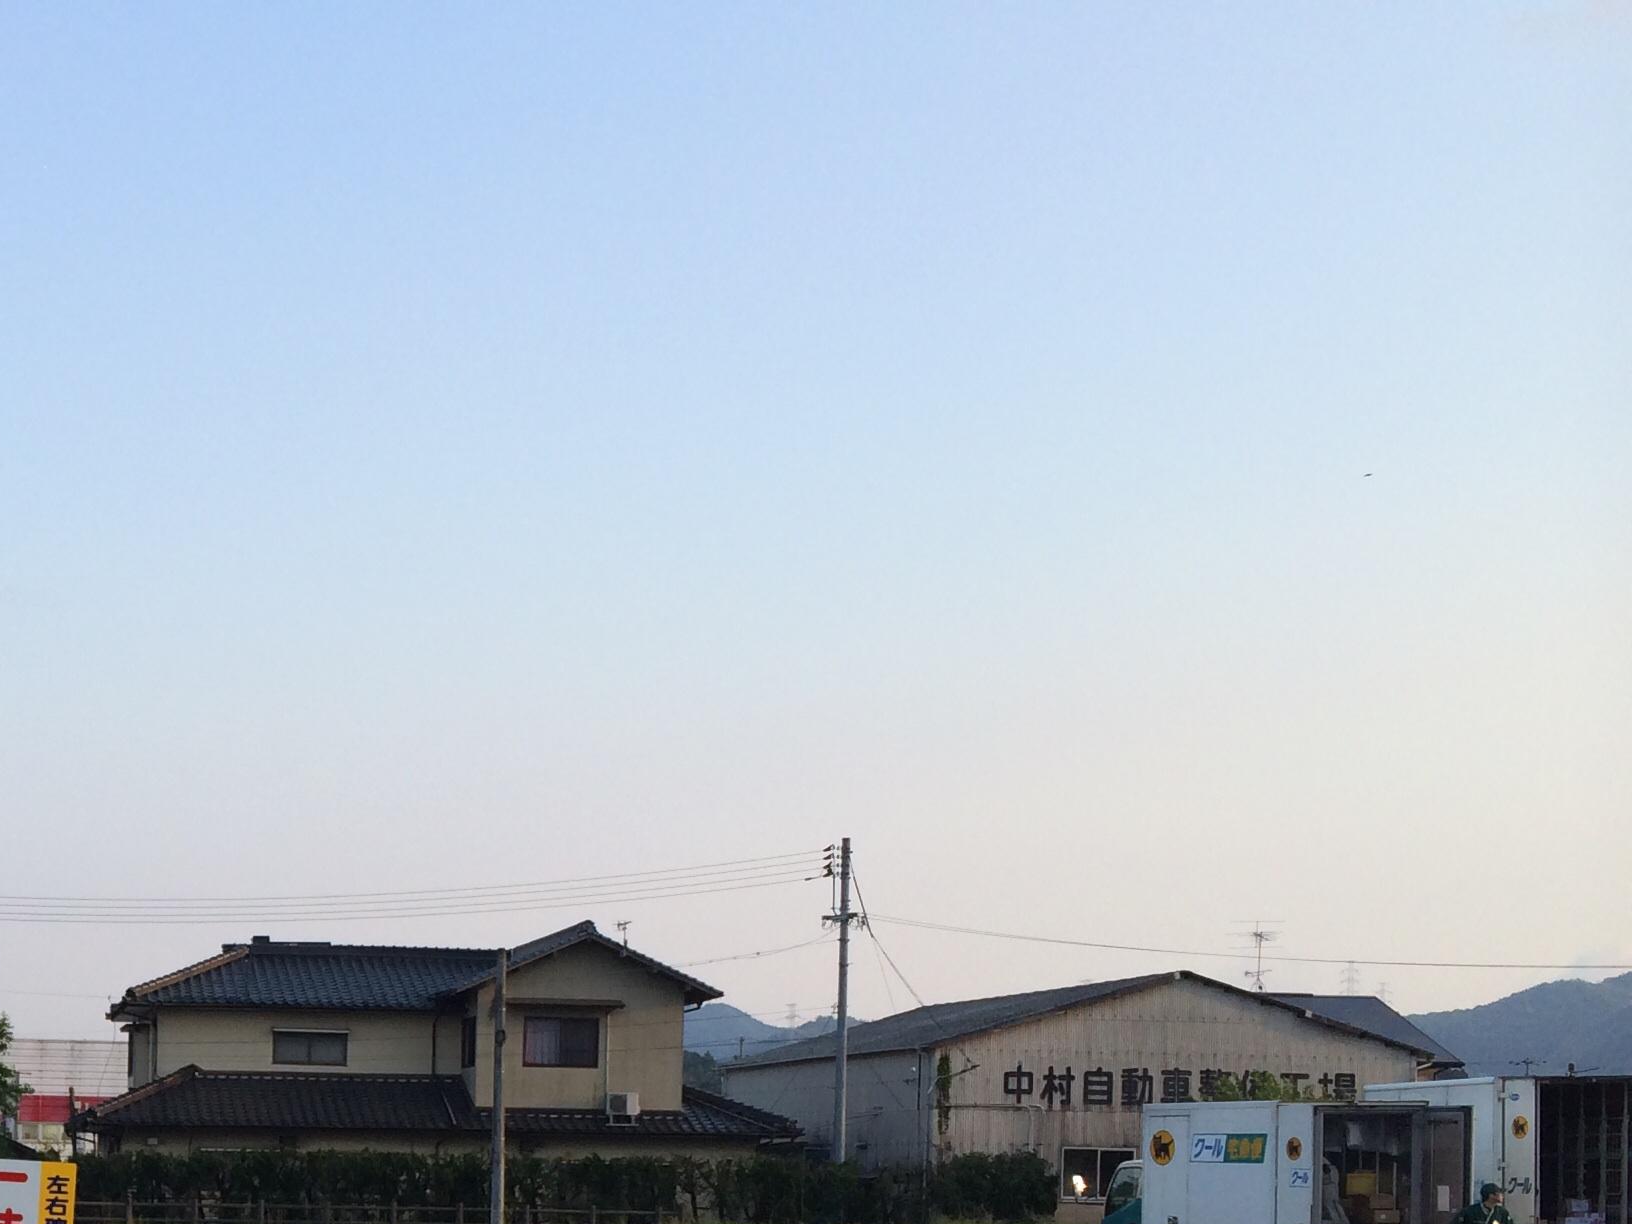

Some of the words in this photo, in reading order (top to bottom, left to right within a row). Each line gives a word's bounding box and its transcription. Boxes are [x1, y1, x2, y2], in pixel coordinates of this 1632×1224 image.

[1292, 1172, 1309, 1184] クール
[1508, 1177, 1533, 1194] クール
